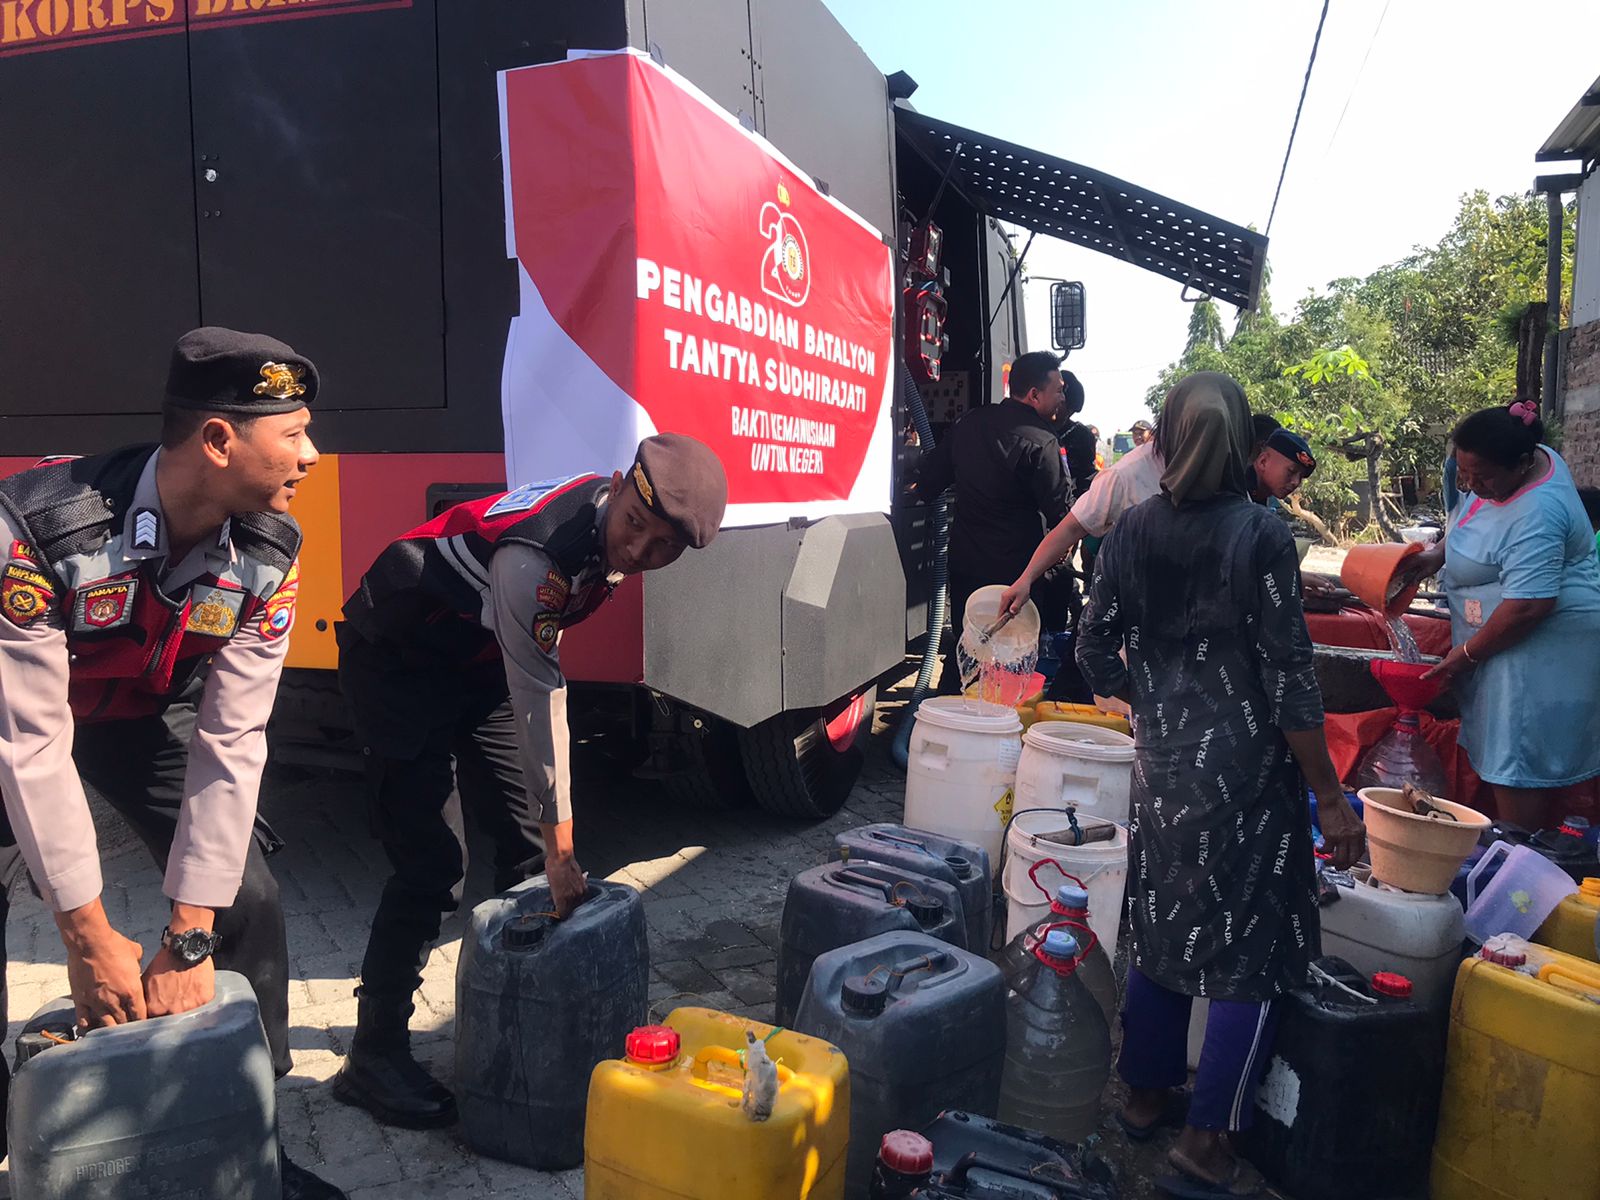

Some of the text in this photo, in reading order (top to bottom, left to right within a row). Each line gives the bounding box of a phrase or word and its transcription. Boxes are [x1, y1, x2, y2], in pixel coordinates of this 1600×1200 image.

[636, 257, 799, 350] PENGABDIAN
[804, 323, 875, 377] BATALYON
[664, 327, 867, 413] TANTYA SUDHIRAJATI
[731, 405, 836, 448] BAKTI KEMANUSIAAN
[751, 442, 824, 475] UNTUK NEGERI
[1263, 572, 1282, 608] PRADA
[1102, 601, 1119, 622] PRA
[1129, 625, 1140, 650] PRA
[1190, 679, 1219, 713] PRADA
[1218, 665, 1235, 697] PRADA
[1156, 703, 1168, 738] PRADA
[1241, 699, 1259, 738] PRADA
[1195, 727, 1215, 769] PRADA
[1235, 811, 1246, 845] PRDA
[1255, 809, 1271, 835] PRADA
[1140, 849, 1148, 879] PRADA
[1198, 830, 1210, 867] PRADA
[1273, 832, 1292, 876] PRADA
[1148, 889, 1157, 925] PRADA
[1224, 911, 1233, 946] PRADA
[1242, 914, 1260, 937] PRADA
[1290, 913, 1305, 949] PRADA
[1183, 926, 1202, 963] PRADA
